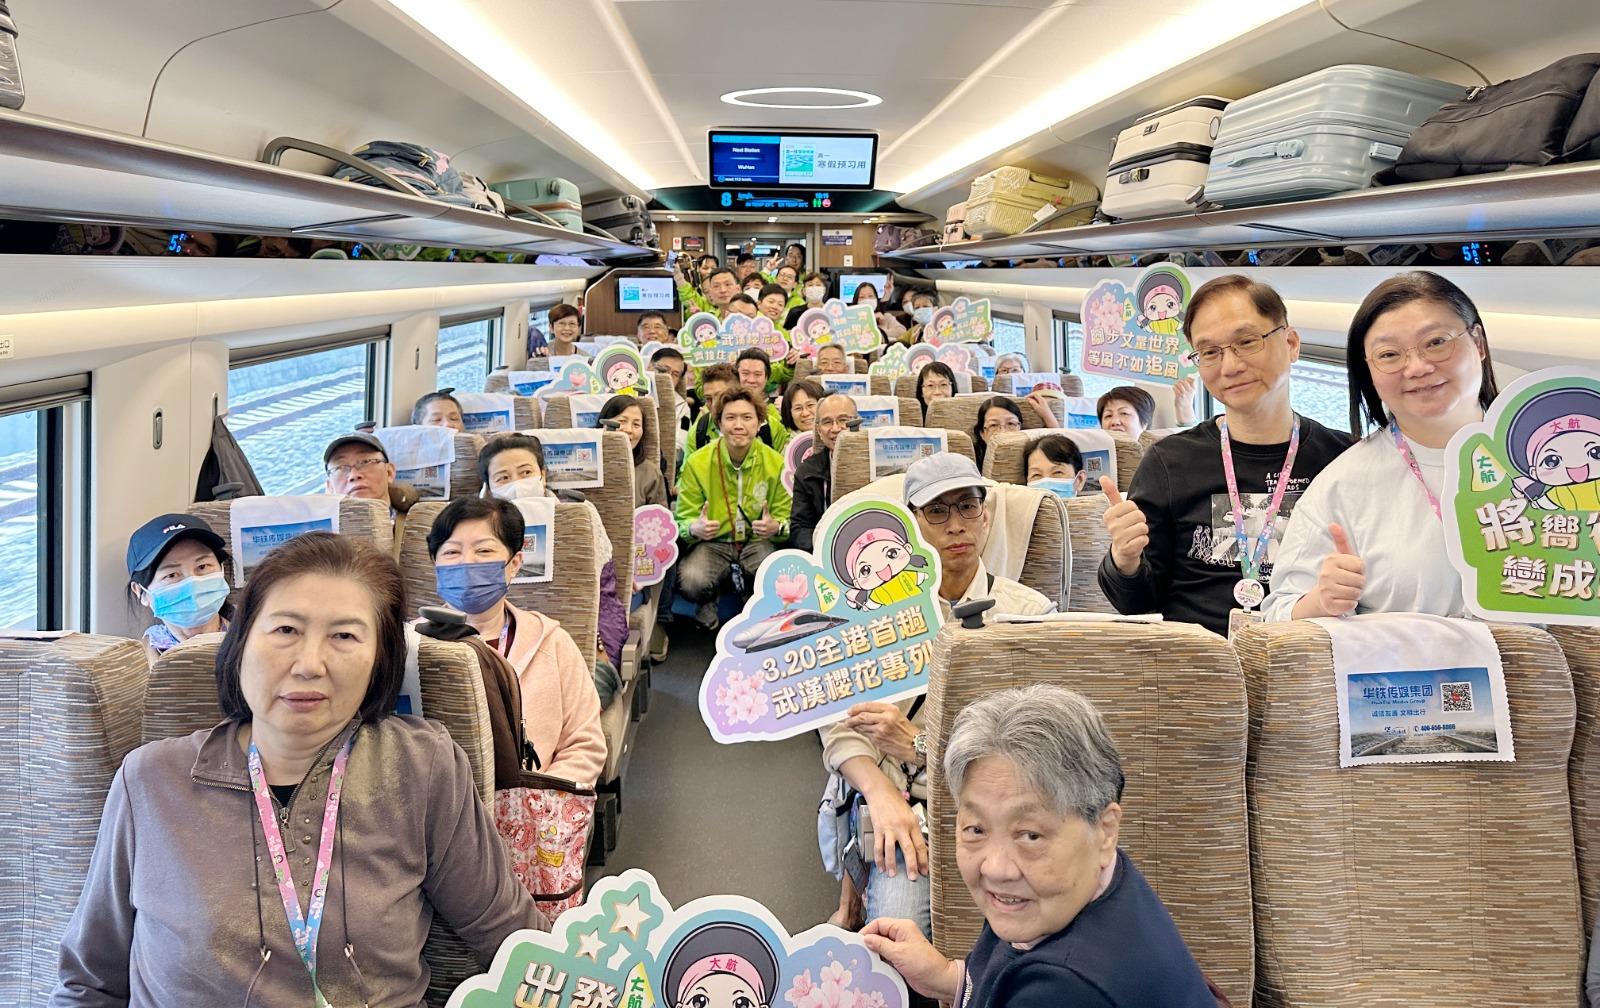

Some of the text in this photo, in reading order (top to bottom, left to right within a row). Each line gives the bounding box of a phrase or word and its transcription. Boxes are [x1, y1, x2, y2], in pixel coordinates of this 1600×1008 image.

[817, 160, 866, 169] 寒假预习用
[721, 192, 732, 207] 8
[1462, 245, 1471, 261] 5
[1549, 418, 1582, 434] 大航
[1476, 454, 1498, 484] 大航
[163, 523, 186, 534] FILA
[817, 581, 834, 604] 大航
[763, 605, 930, 683] 3.20全港首趟
[771, 641, 933, 720] 武漢櫻花專列
[1363, 684, 1433, 699] 华铁传媒集团
[709, 957, 738, 972] 大航
[627, 977, 645, 1008] 大航
